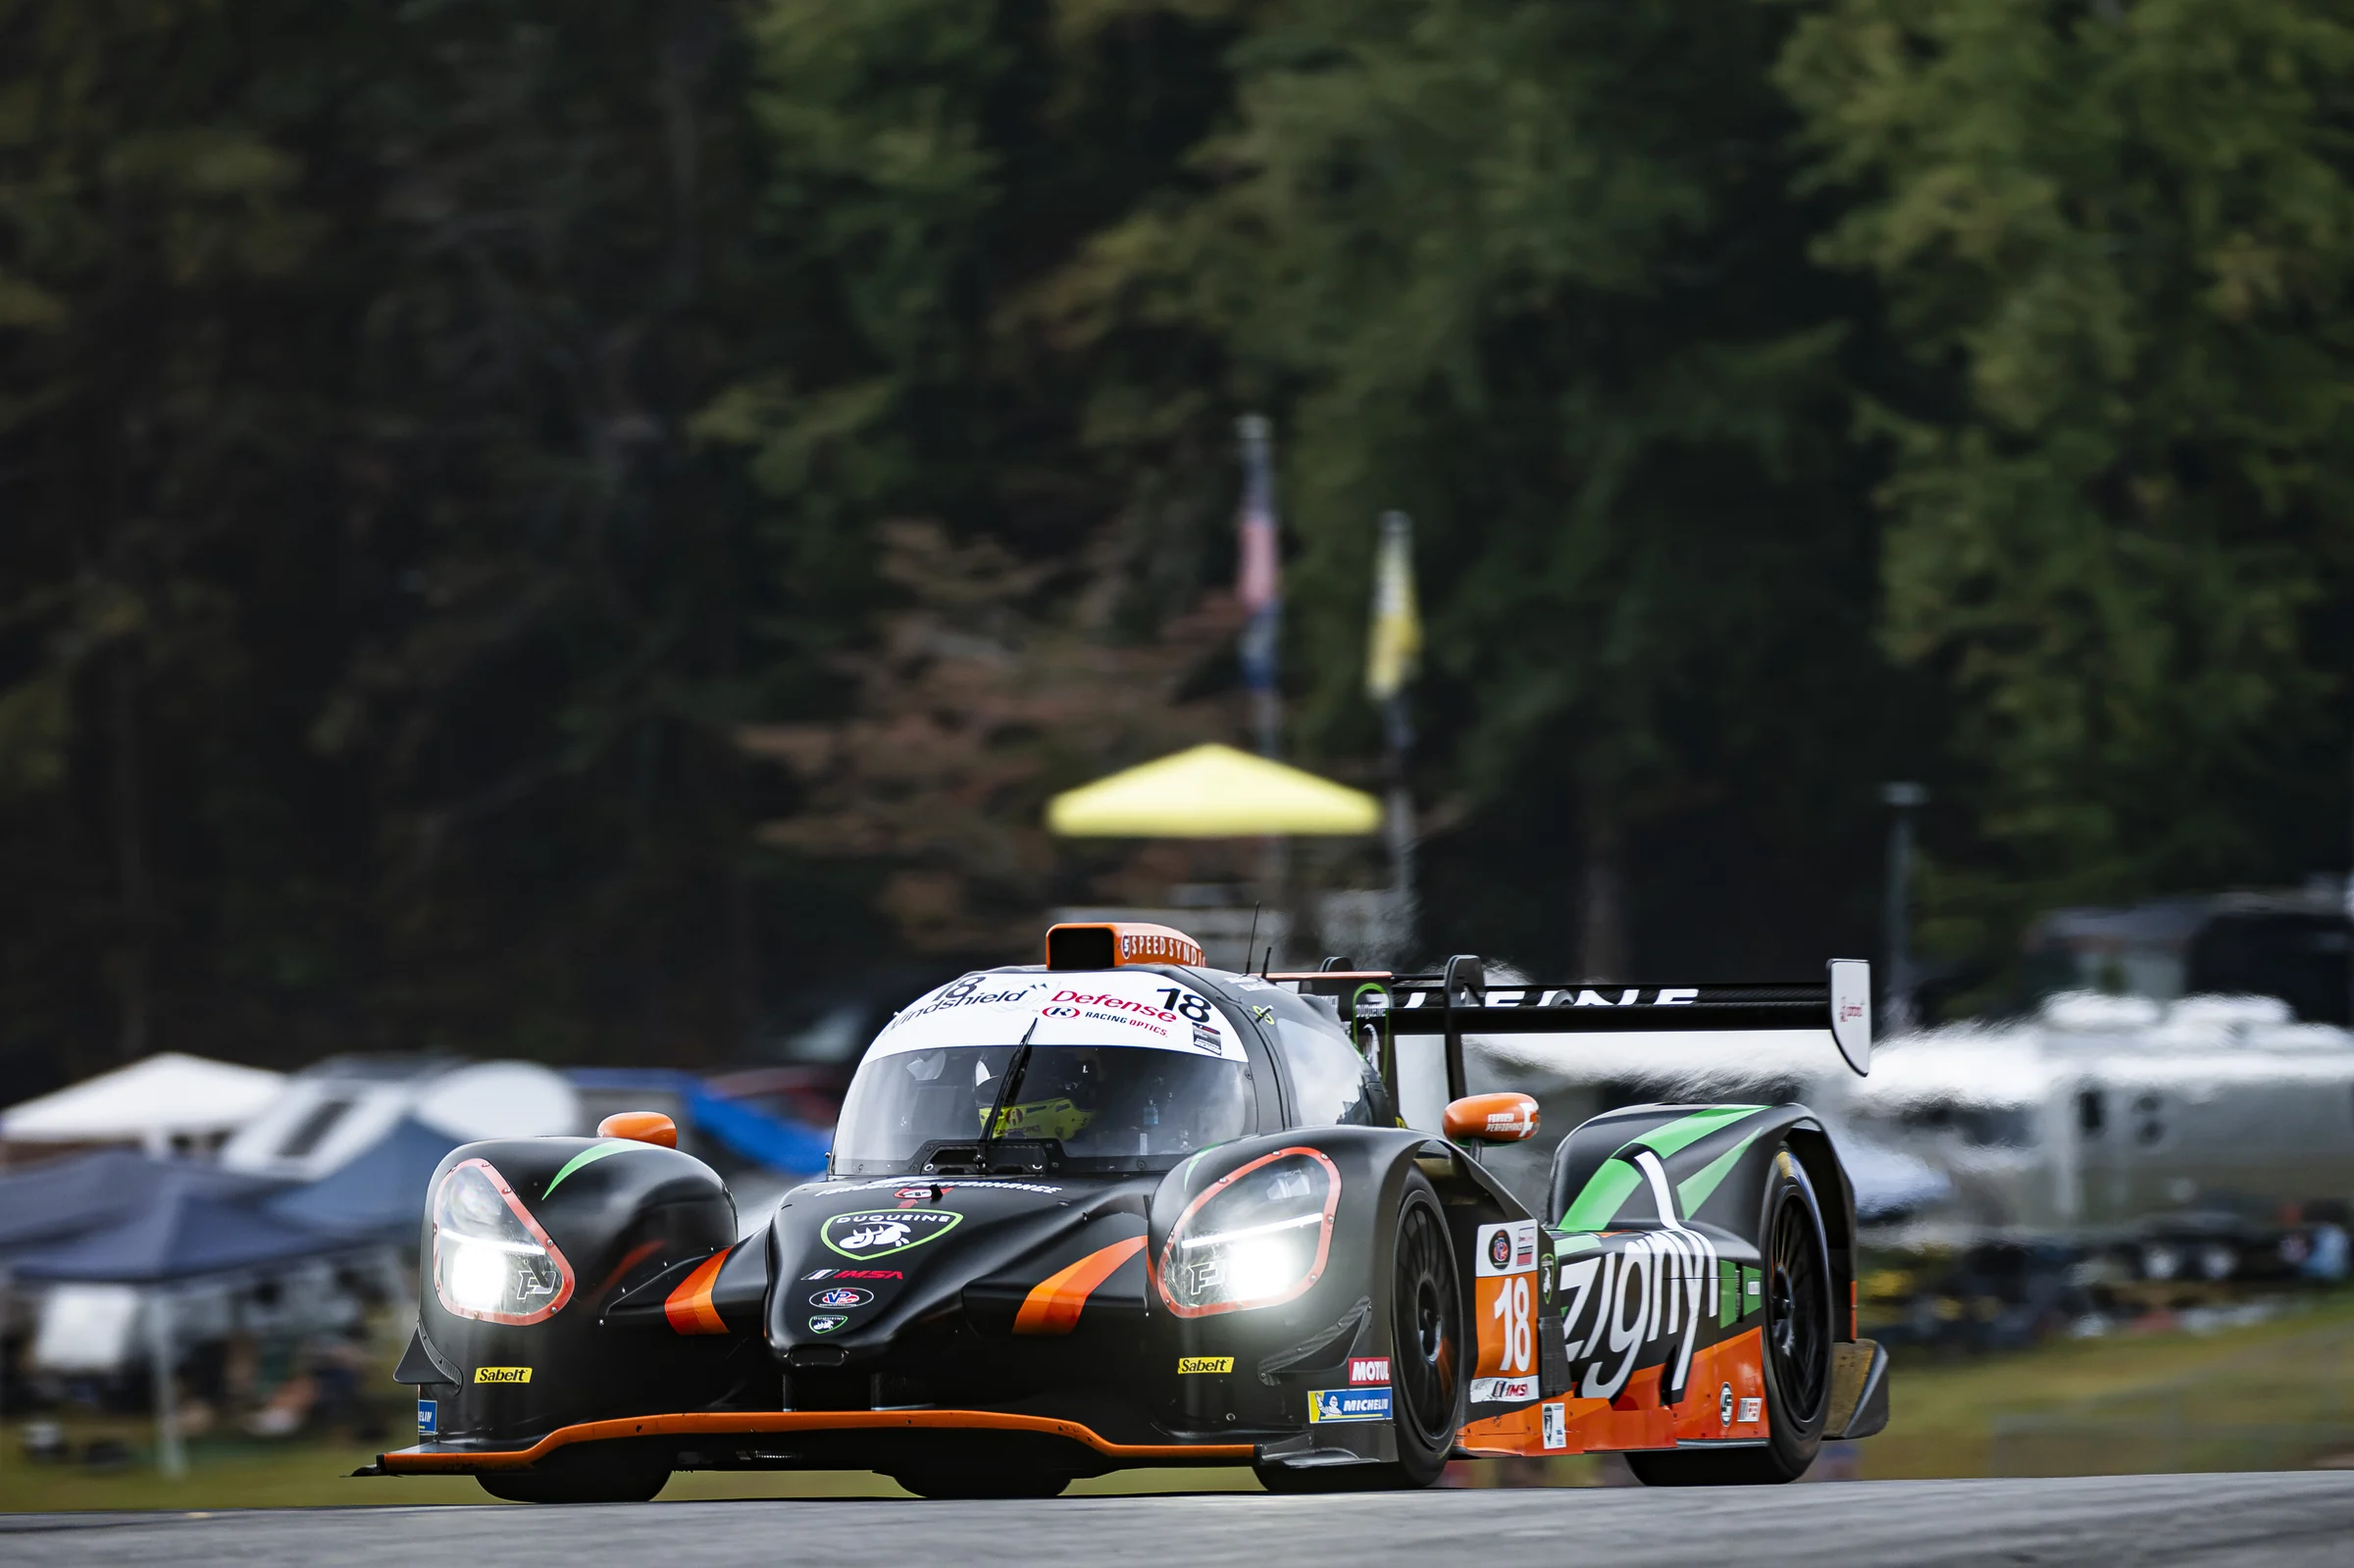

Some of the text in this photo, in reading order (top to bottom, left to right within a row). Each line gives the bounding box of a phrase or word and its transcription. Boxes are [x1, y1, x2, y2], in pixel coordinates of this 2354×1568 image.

[1131, 935, 1166, 955] SPEED
[932, 976, 987, 1002] 18
[1051, 990, 1177, 1023] Defense
[1156, 987, 1212, 1024] 18
[1085, 1011, 1128, 1025] RACING
[1129, 1019, 1167, 1037] OPTICS
[836, 1214, 952, 1225] DUQUEINE
[833, 1270, 903, 1280] IMSA
[1494, 1277, 1531, 1372] 18
[479, 1368, 526, 1382] Sabelt
[1181, 1359, 1226, 1372] Sabelt
[1352, 1361, 1390, 1382] MOTUL
[1343, 1397, 1389, 1412] MICHELIN
